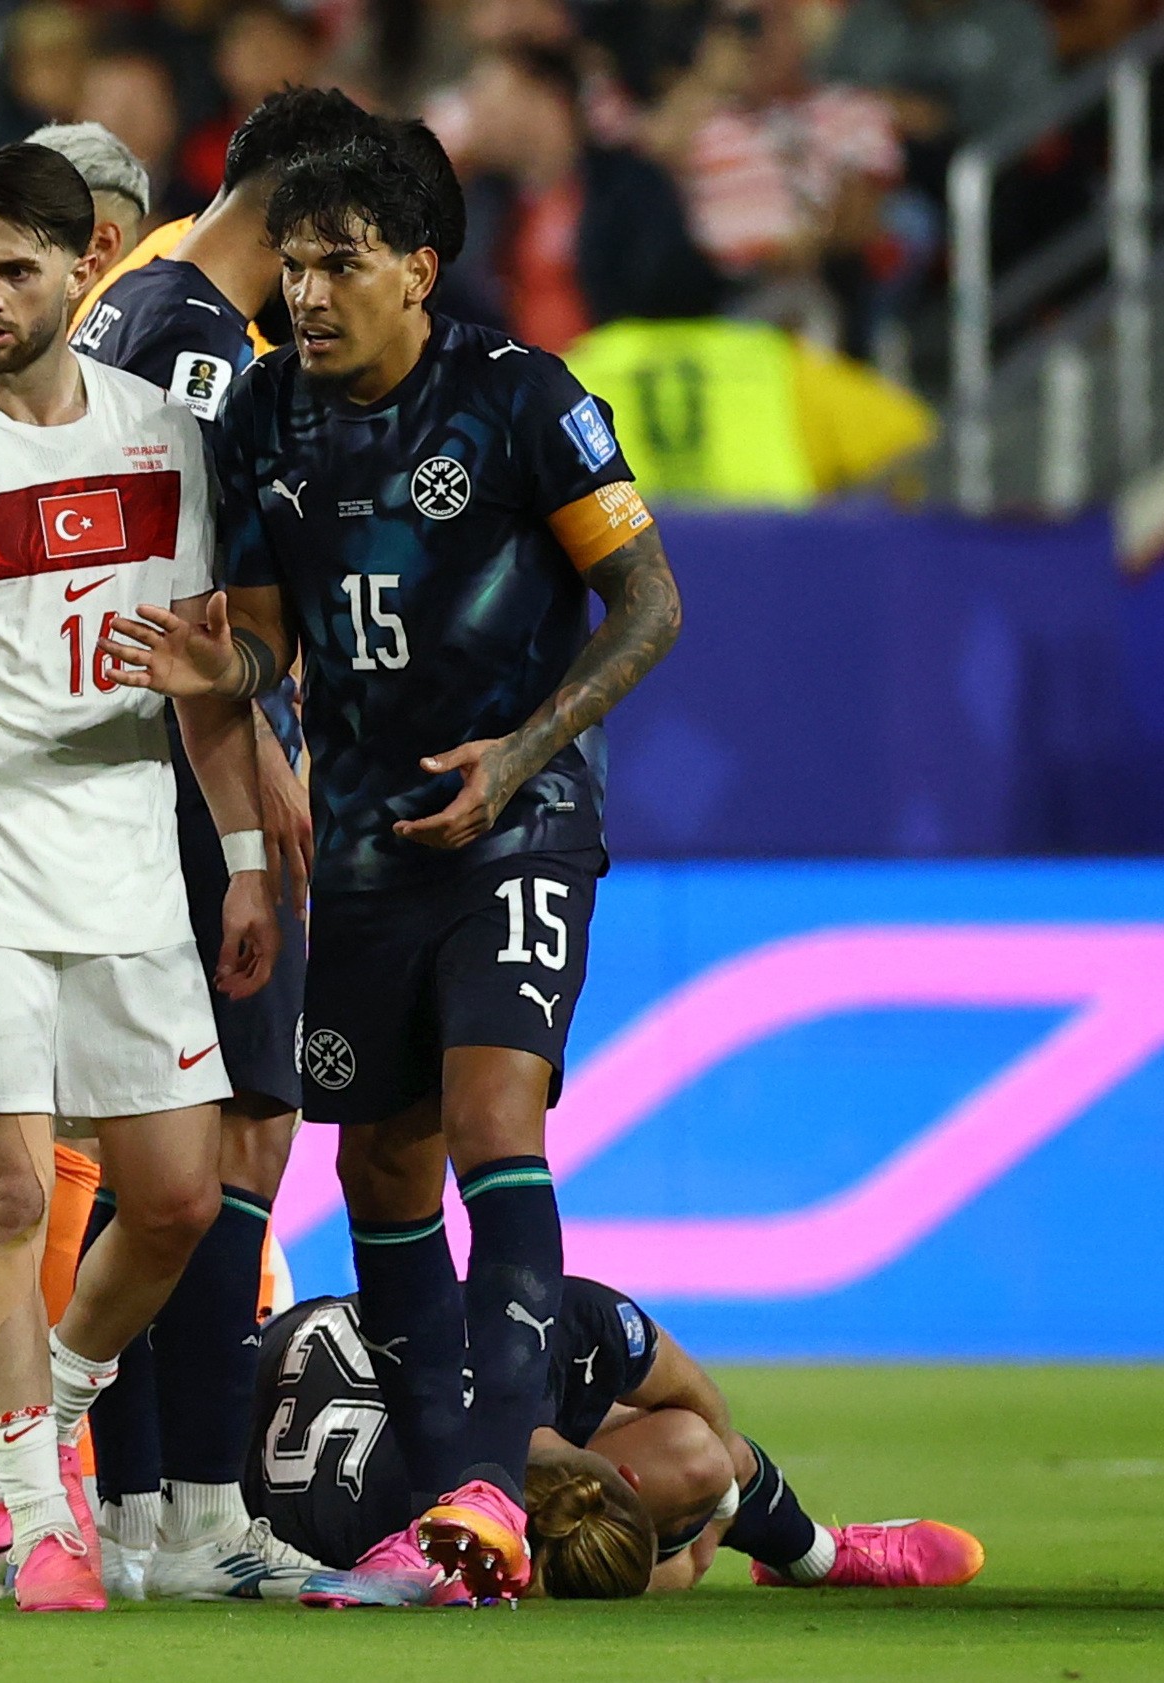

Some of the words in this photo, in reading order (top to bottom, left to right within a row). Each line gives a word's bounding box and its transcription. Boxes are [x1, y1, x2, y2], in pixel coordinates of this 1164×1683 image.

[431, 461, 451, 473] APF
[60, 611, 124, 697] 16
[340, 574, 411, 670] 15
[494, 877, 569, 971] 15
